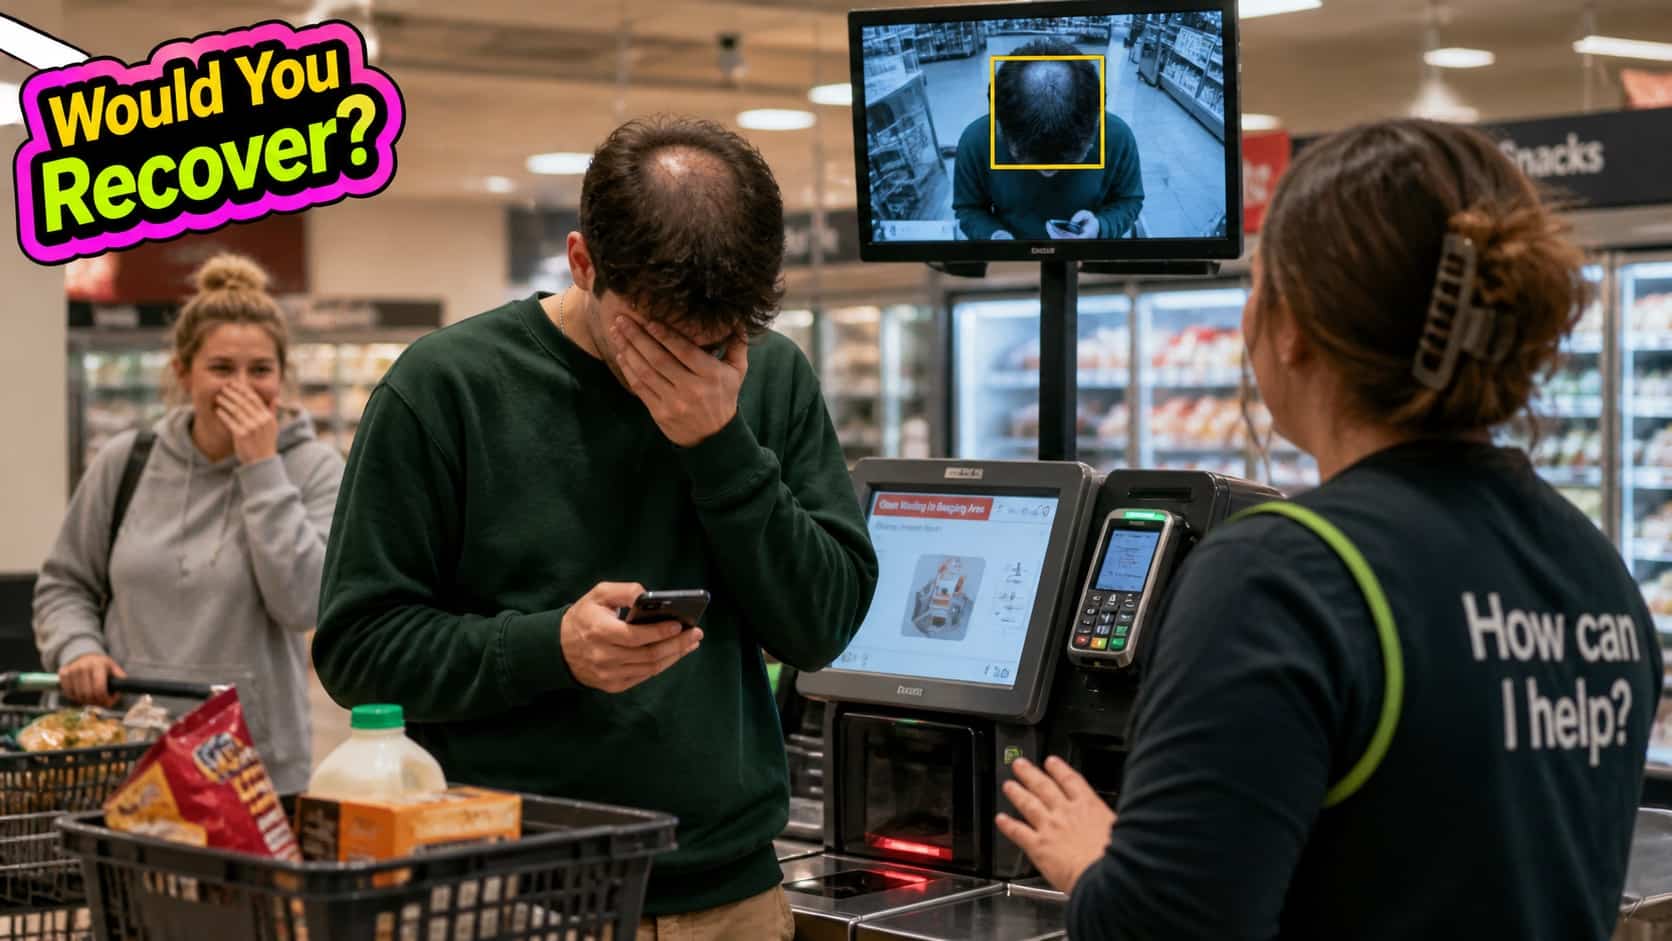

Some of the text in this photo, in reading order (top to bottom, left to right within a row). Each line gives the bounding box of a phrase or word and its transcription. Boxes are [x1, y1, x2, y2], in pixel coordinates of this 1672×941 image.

[1461, 591, 1641, 663] How can
[1501, 676, 1633, 767] I help?
